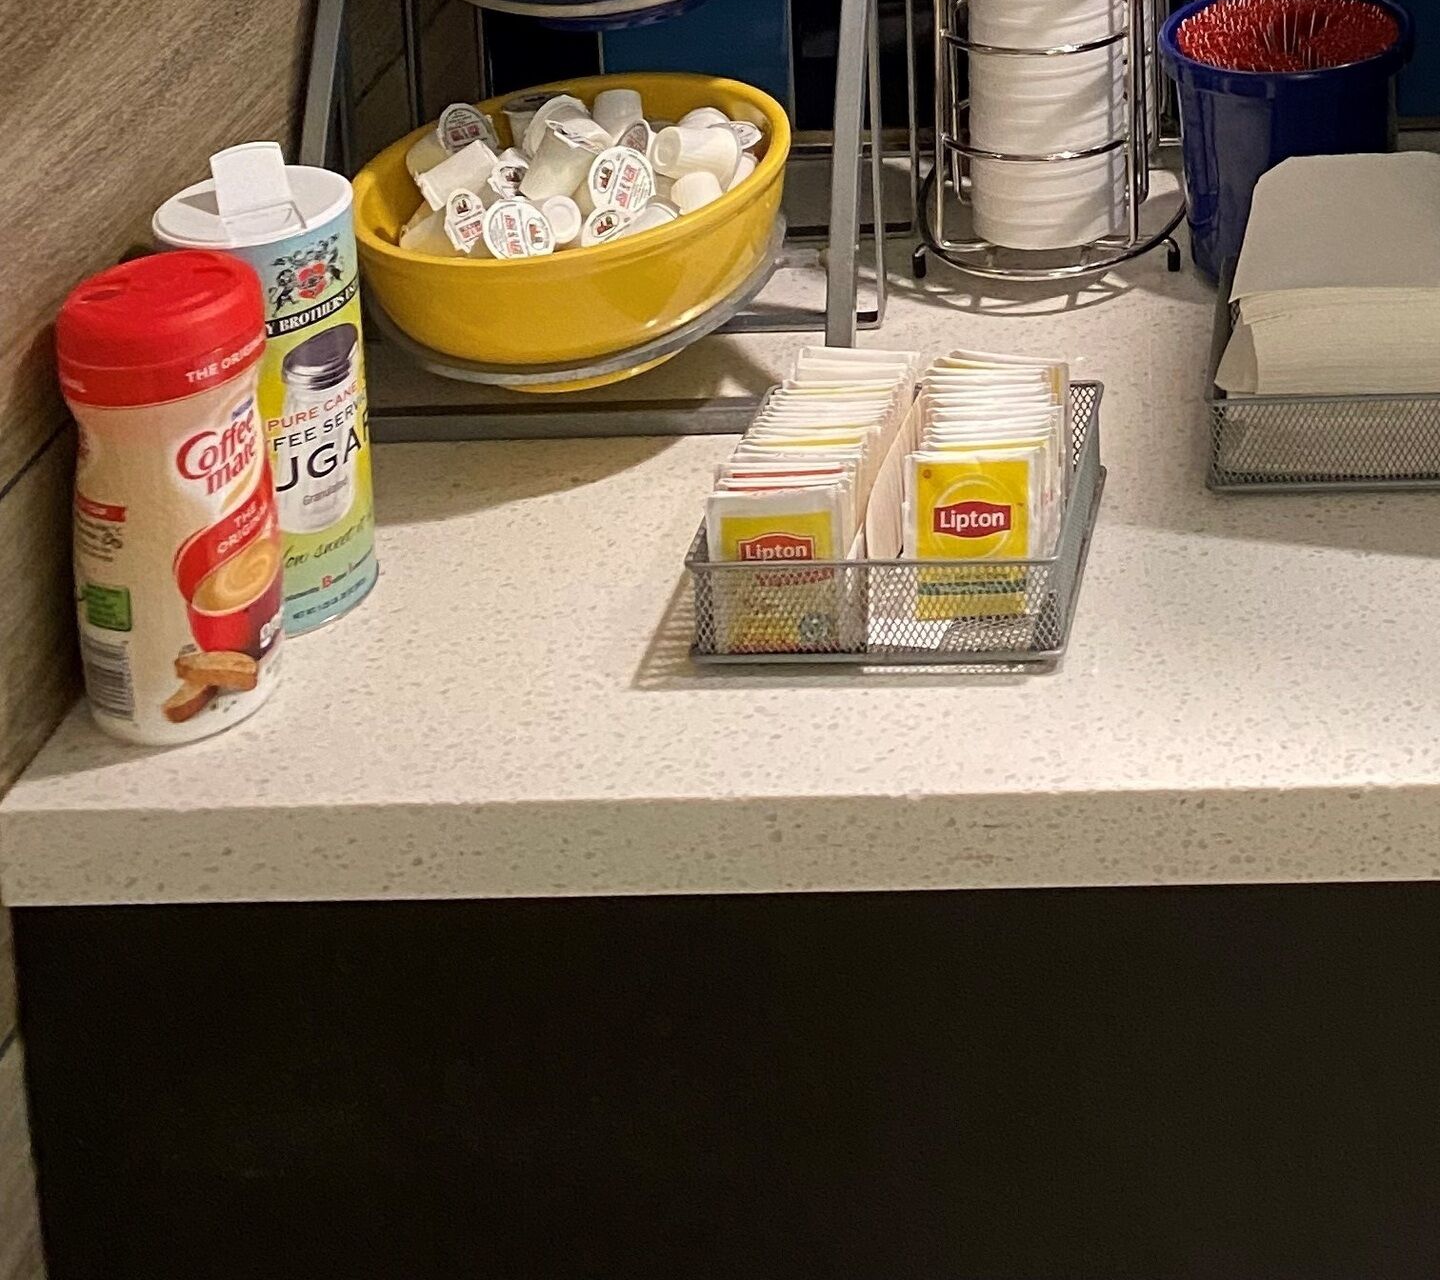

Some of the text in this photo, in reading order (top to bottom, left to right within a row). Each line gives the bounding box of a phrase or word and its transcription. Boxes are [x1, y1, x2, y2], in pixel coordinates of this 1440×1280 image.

[279, 294, 346, 333] BROTHERS
[185, 362, 219, 383] THE
[267, 406, 319, 432] PURE
[323, 380, 357, 412] CANE
[273, 426, 317, 452] FEE
[275, 407, 369, 493] UGA
[205, 436, 256, 496] mate
[234, 500, 257, 530] THE
[940, 510, 1005, 532] Lipton
[745, 544, 808, 562] Lipton
